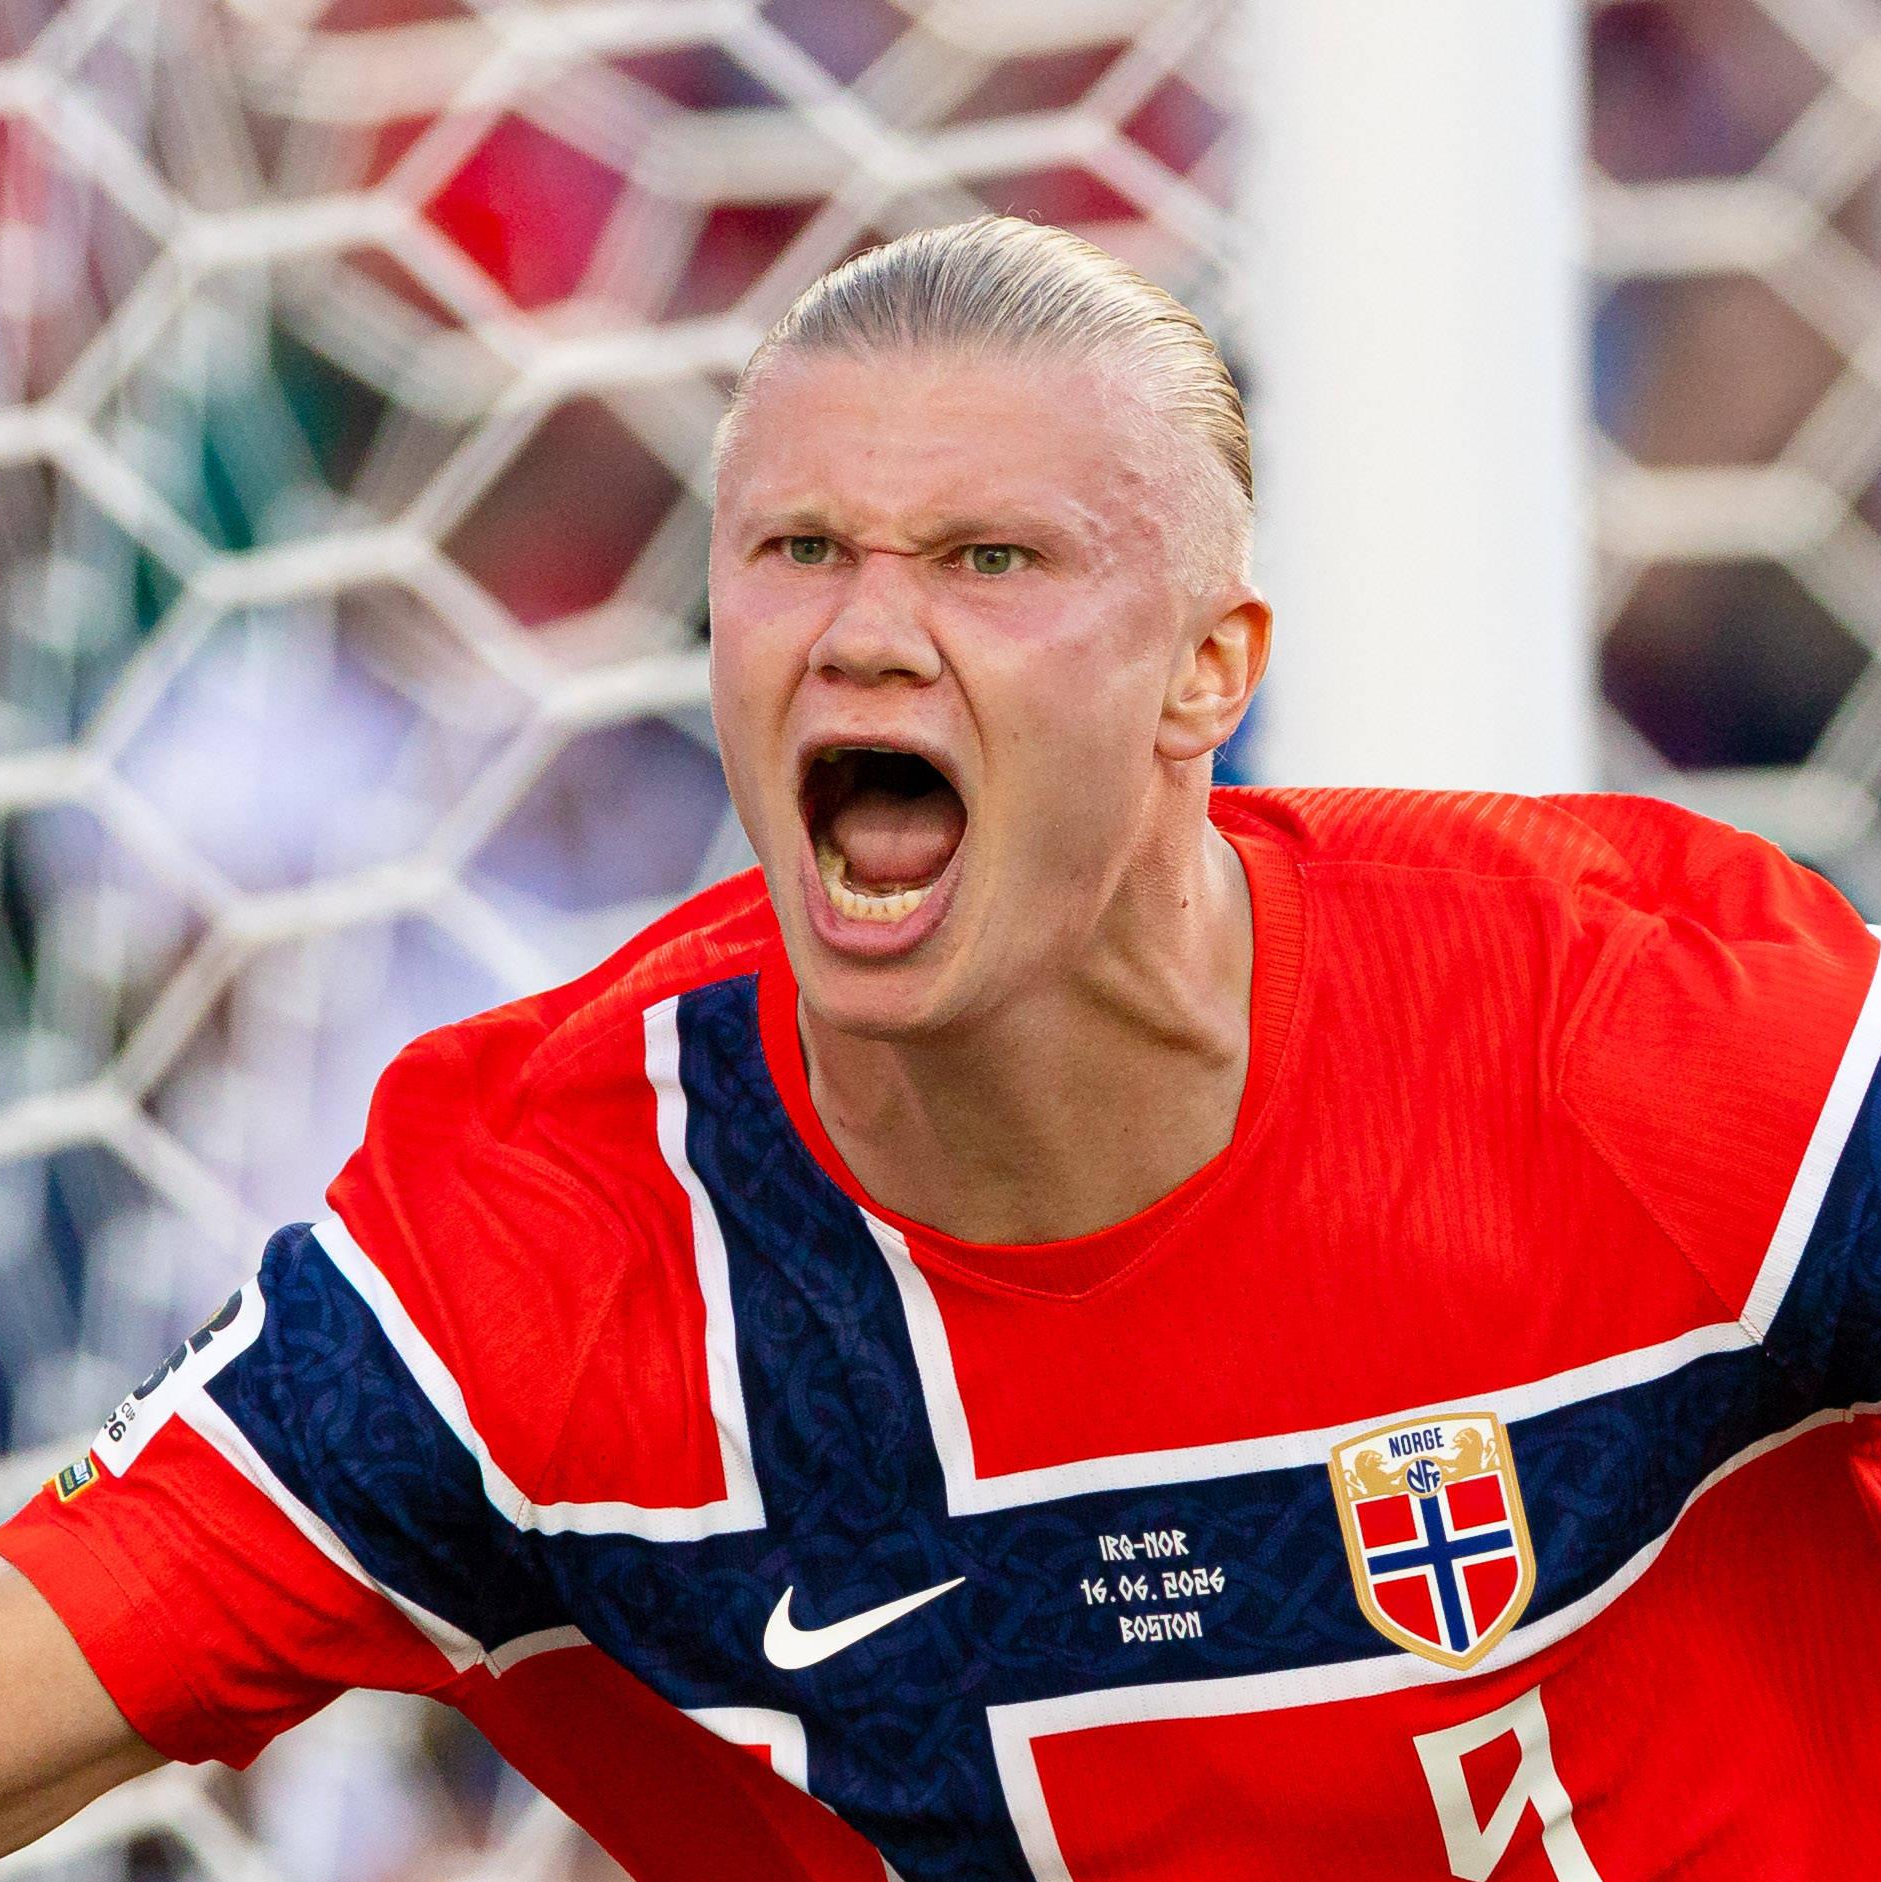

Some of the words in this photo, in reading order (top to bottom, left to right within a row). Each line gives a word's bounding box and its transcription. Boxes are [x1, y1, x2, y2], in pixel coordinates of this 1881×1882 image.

[1388, 1426, 1445, 1458] NORGE
[1098, 1529, 1190, 1561] IRQ-NOR
[1119, 1611, 1203, 1643] BOSTON
